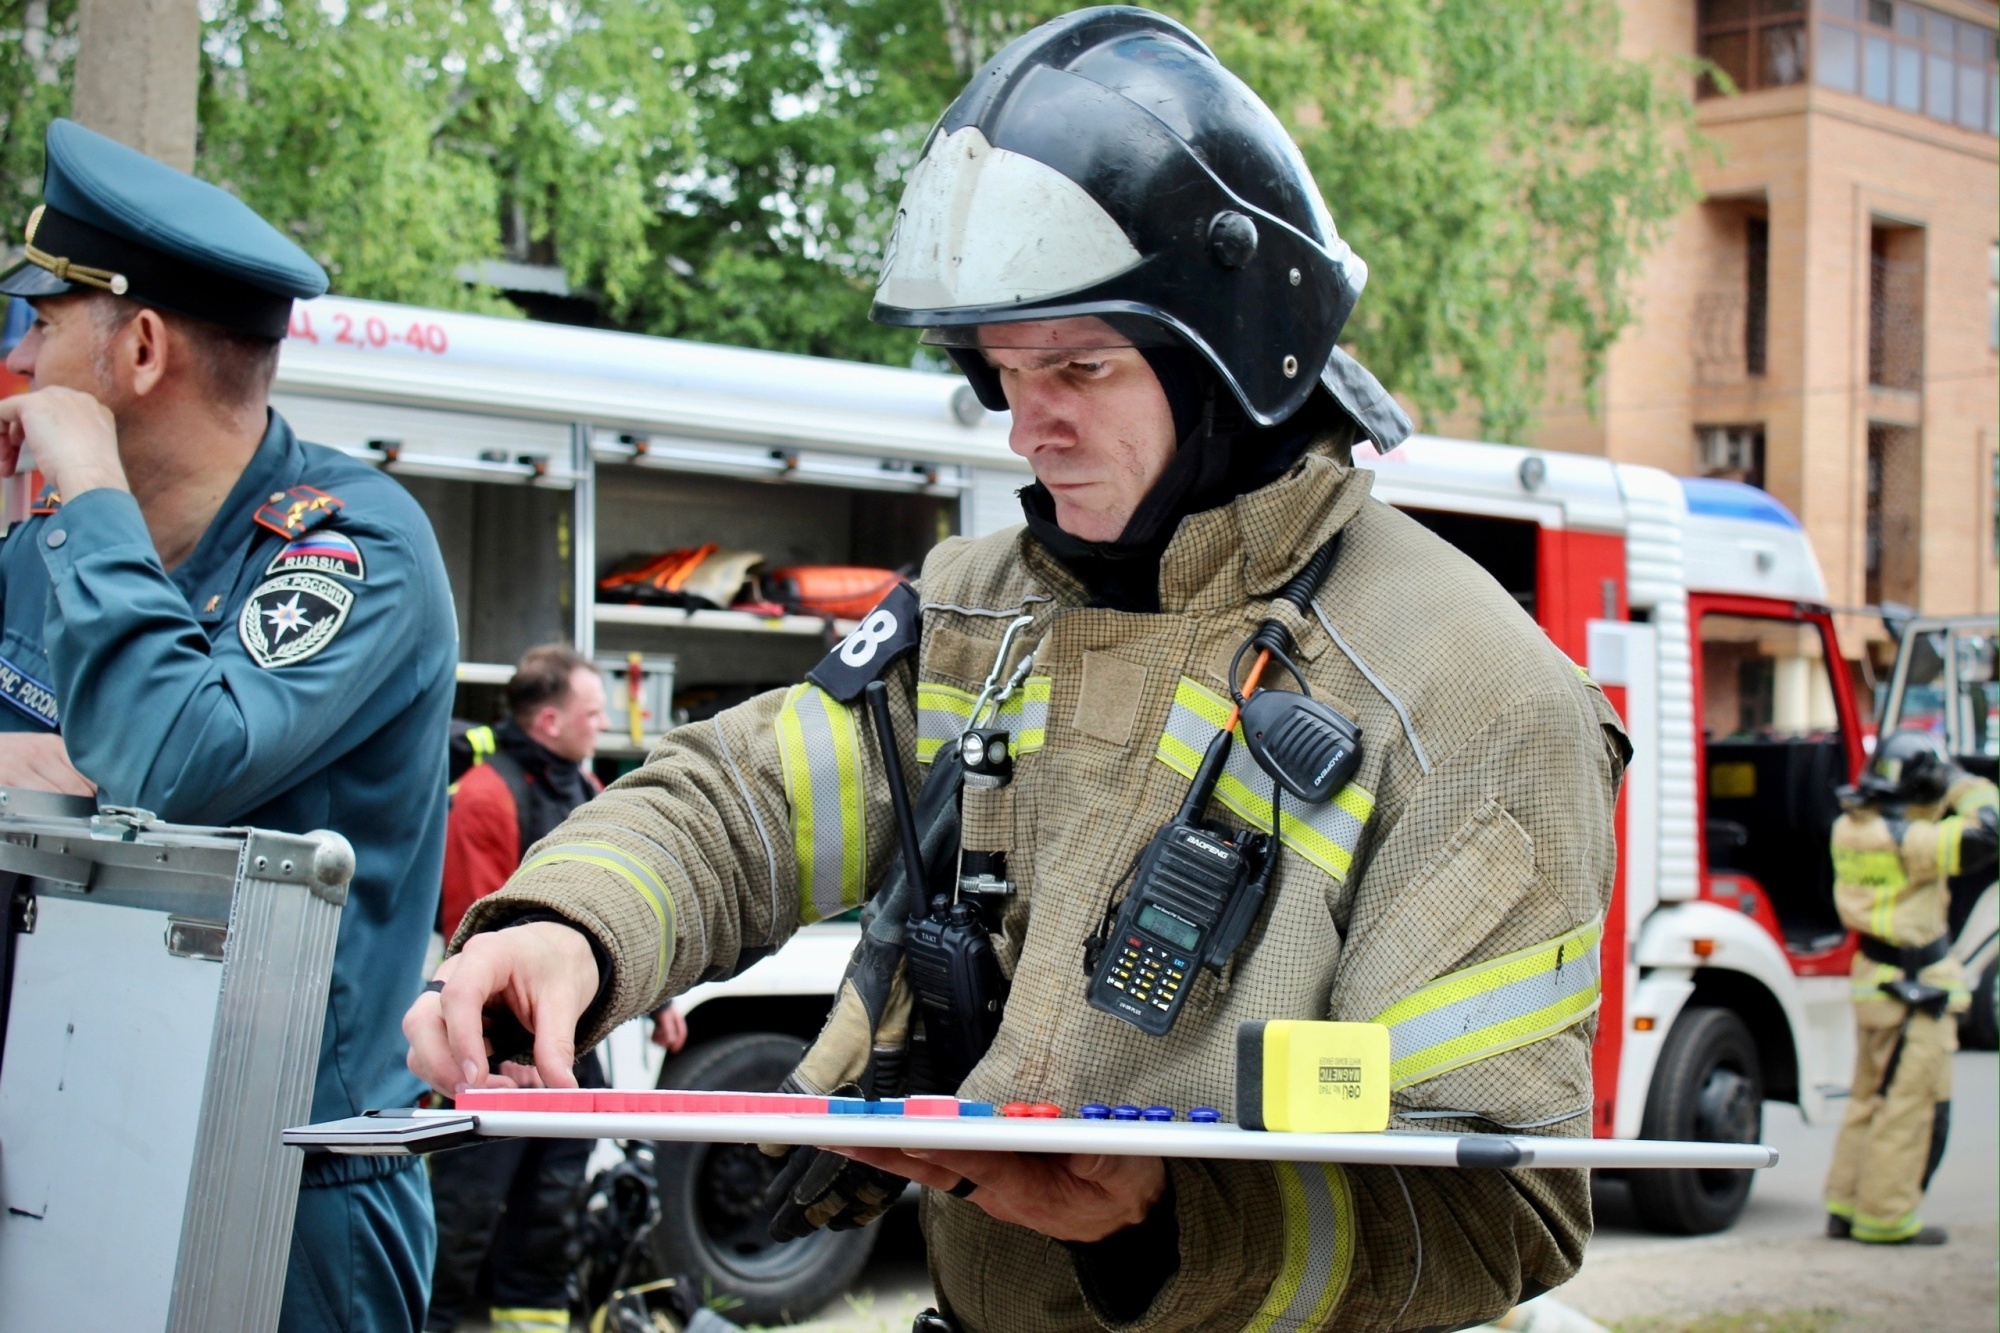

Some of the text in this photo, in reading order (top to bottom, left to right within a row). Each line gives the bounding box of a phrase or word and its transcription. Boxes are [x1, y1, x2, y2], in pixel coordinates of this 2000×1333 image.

[333, 312, 448, 355] 2,0-40
[284, 555, 346, 572] RUSSIA
[291, 577, 347, 604] РОССИИ
[1314, 750, 1344, 786] BAOFENG
[1186, 835, 1229, 859] BAOFENG
[1173, 959, 1185, 967] EXIT
[1320, 1068, 1361, 1081] MAGNETIC
[1342, 1084, 1361, 1100] deli
